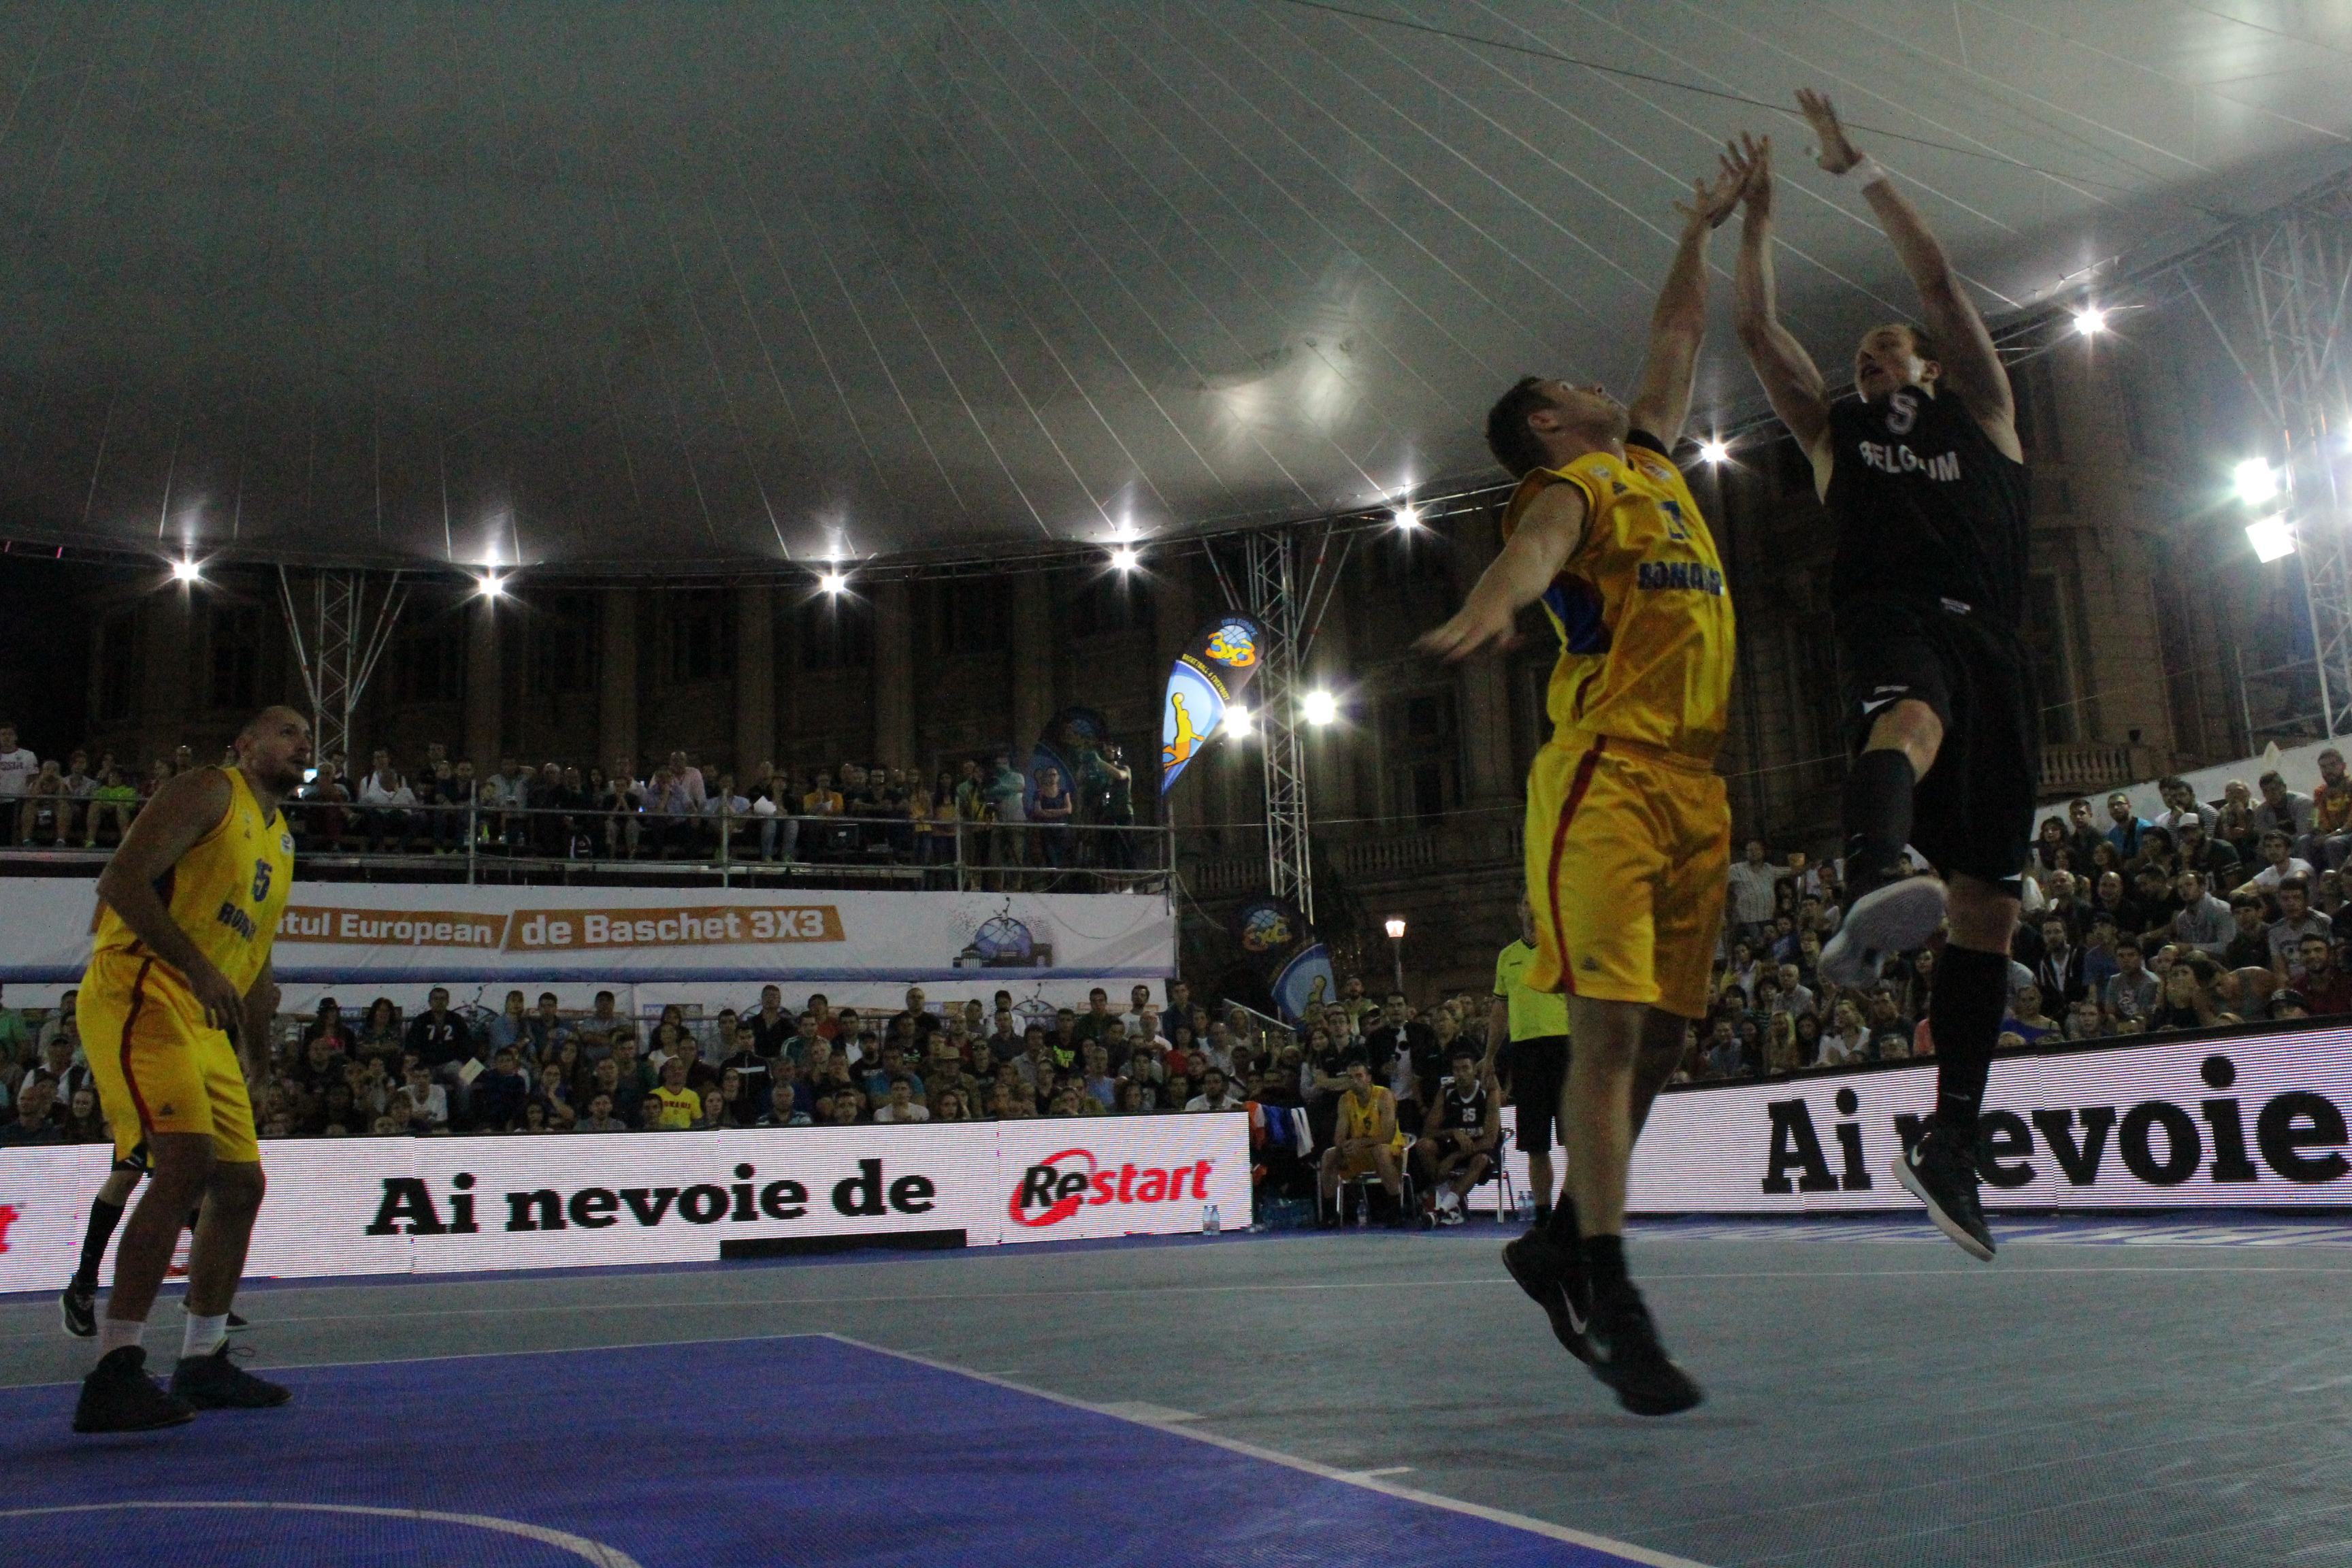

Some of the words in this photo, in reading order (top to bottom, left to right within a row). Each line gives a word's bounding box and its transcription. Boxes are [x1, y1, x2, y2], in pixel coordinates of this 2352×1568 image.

[341, 913, 493, 945] European
[521, 914, 572, 945] de
[584, 912, 742, 944] Baschet
[1761, 1088, 1874, 1194] Ai
[1895, 1056, 2350, 1188] evoie
[366, 1172, 479, 1235] Ai
[506, 1163, 808, 1232] nevoie
[831, 1158, 936, 1218] de
[1022, 1159, 1212, 1209] Restart
